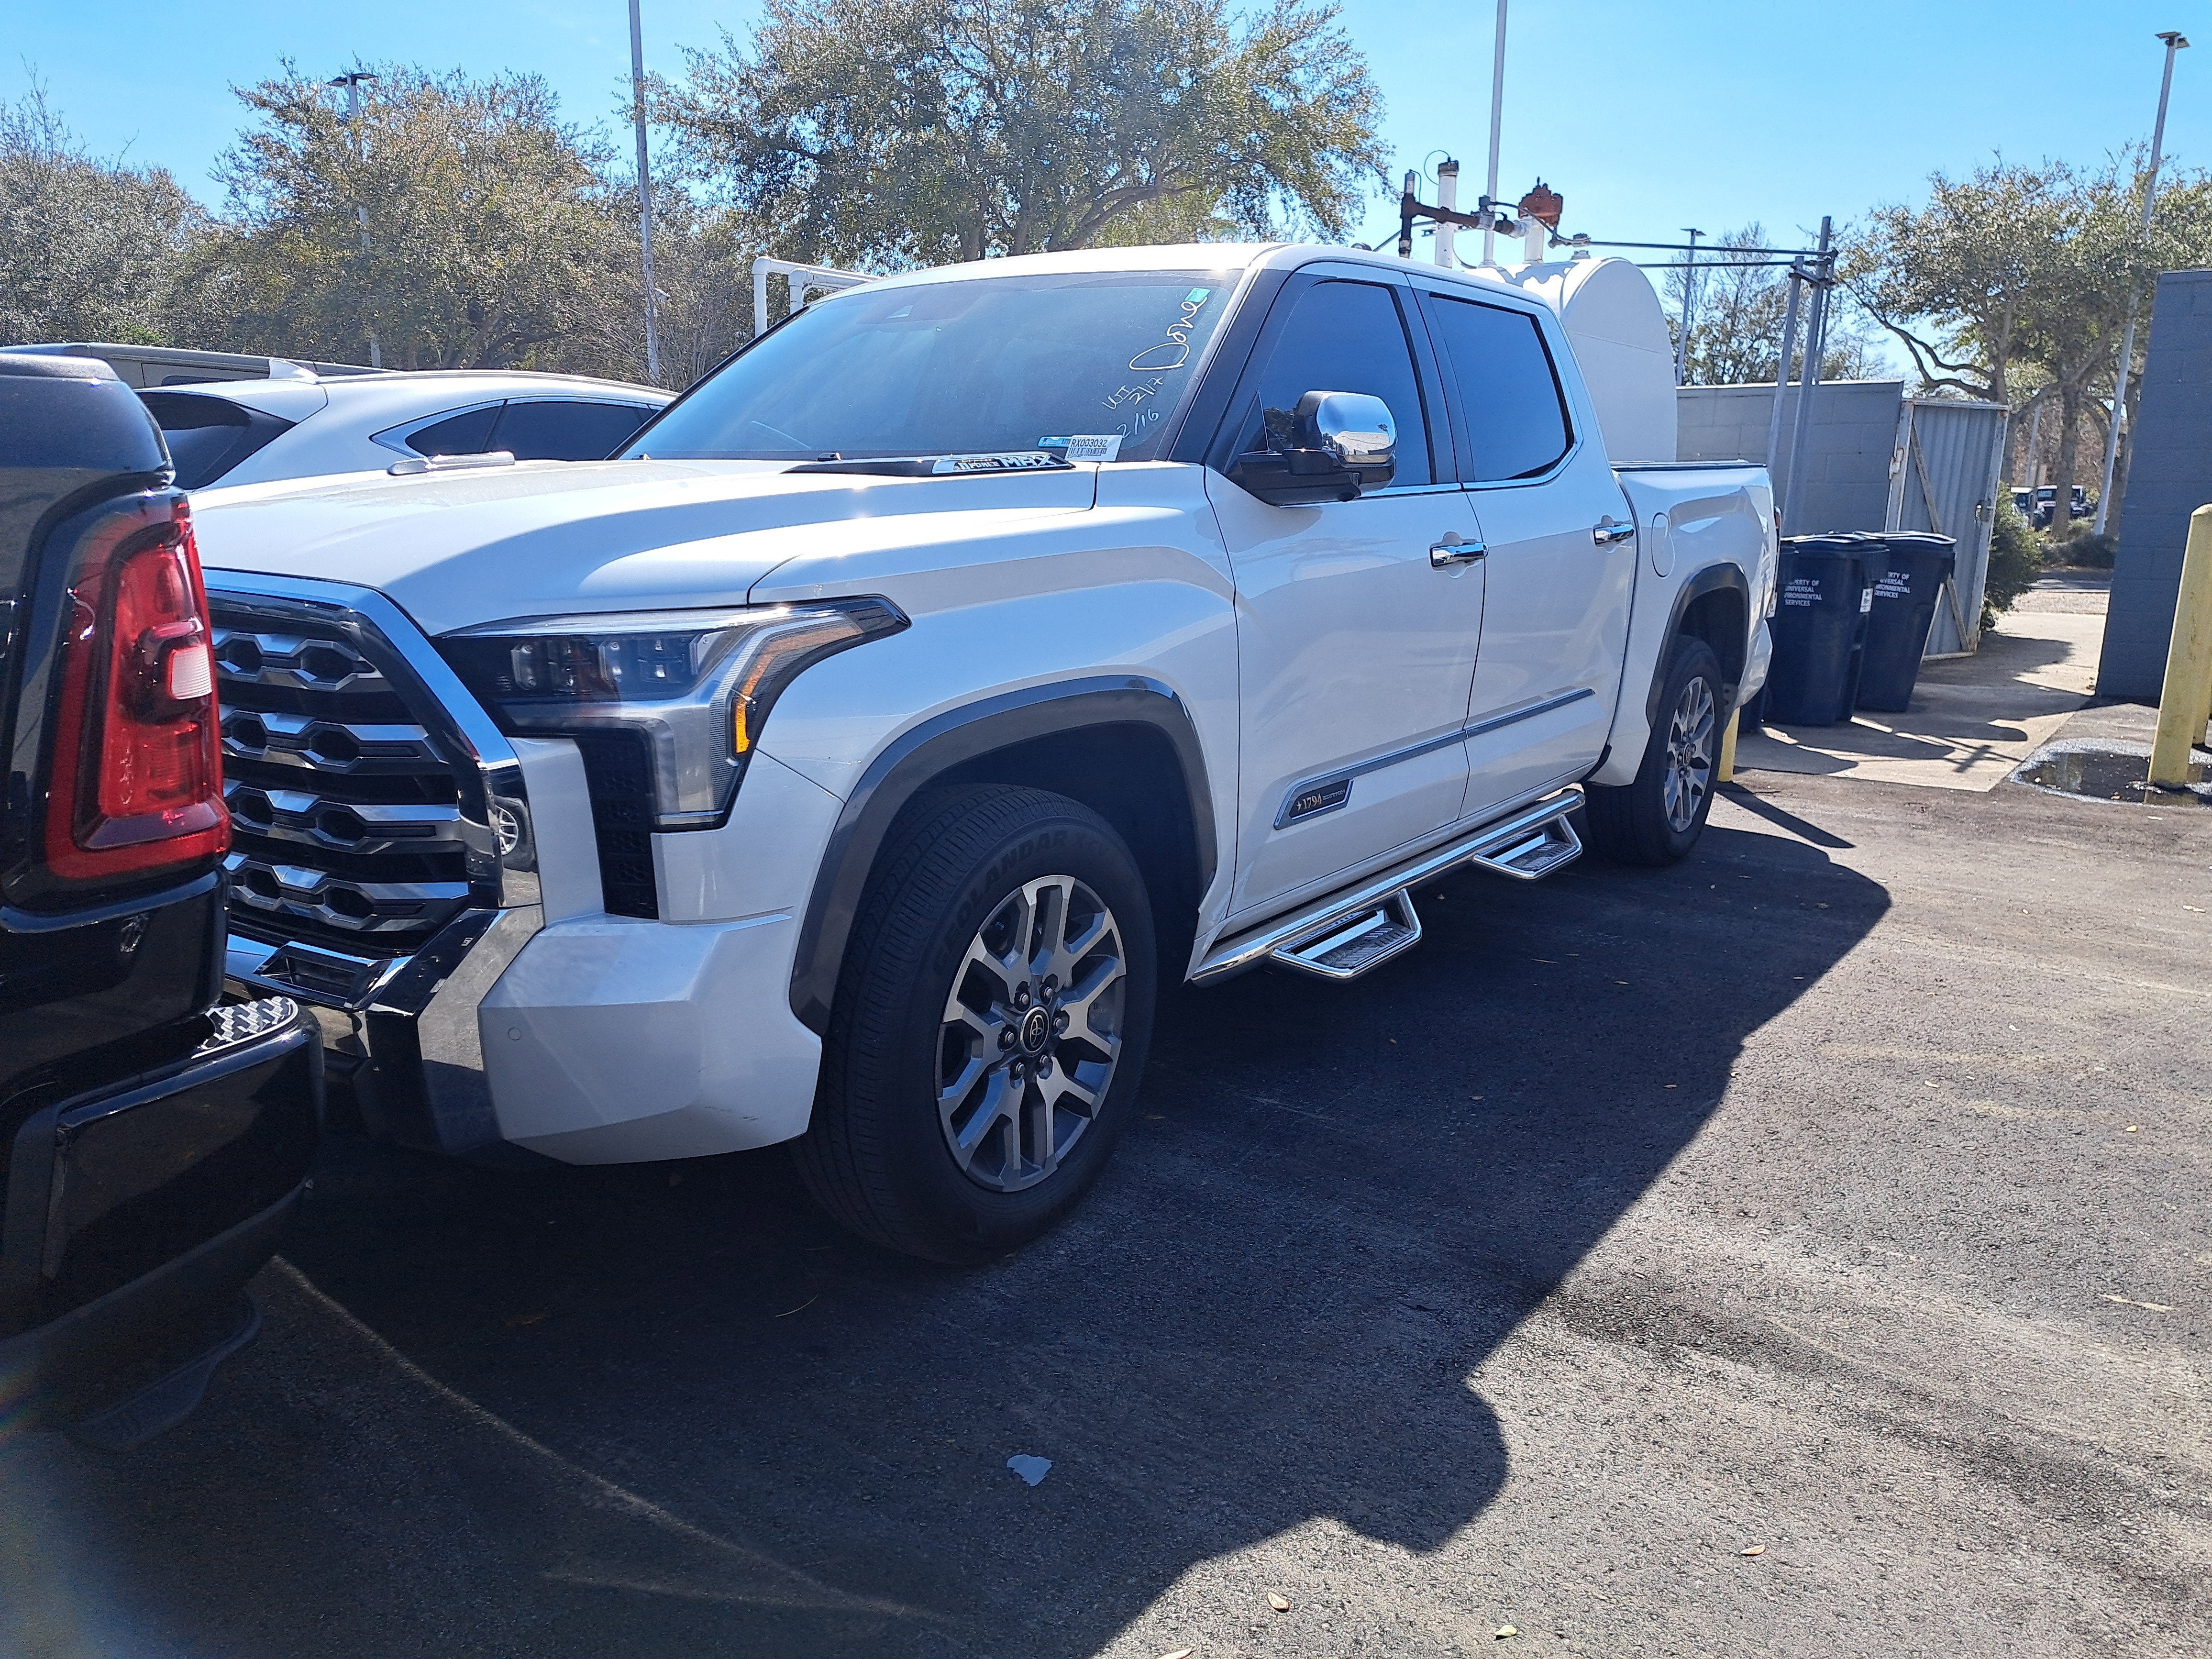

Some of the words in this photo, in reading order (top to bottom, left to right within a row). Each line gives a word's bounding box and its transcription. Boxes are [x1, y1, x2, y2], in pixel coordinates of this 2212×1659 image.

[1116, 408, 1159, 439] 2/16
[1071, 439, 1108, 447] RX003032
[995, 455, 1057, 467] MAX
[1811, 578, 1820, 586] OF
[1303, 793, 1322, 809] 1794
[1323, 789, 1345, 801] EDITION
